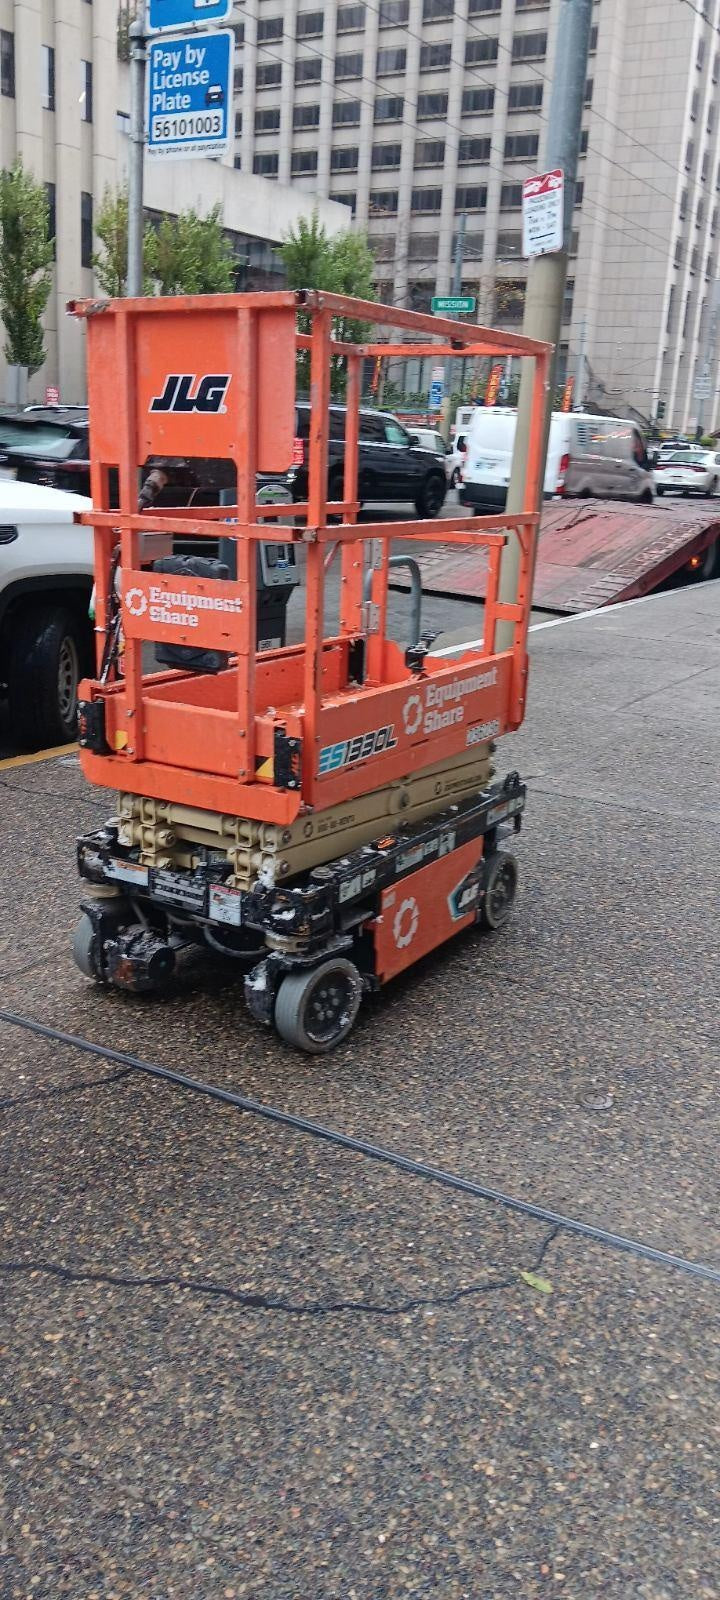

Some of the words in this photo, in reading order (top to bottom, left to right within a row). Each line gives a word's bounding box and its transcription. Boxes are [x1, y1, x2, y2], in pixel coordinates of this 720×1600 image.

[153, 49, 182, 71] Pay
[185, 44, 207, 67] by
[152, 69, 210, 91] License
[152, 92, 191, 112] Plate
[154, 115, 221, 138] 56101003
[149, 374, 231, 413] JLG
[149, 586, 243, 613] Equipment
[149, 605, 199, 627] Share
[425, 667, 497, 708] Equipment
[423, 706, 464, 735] Share
[318, 724, 398, 775] ES1330L
